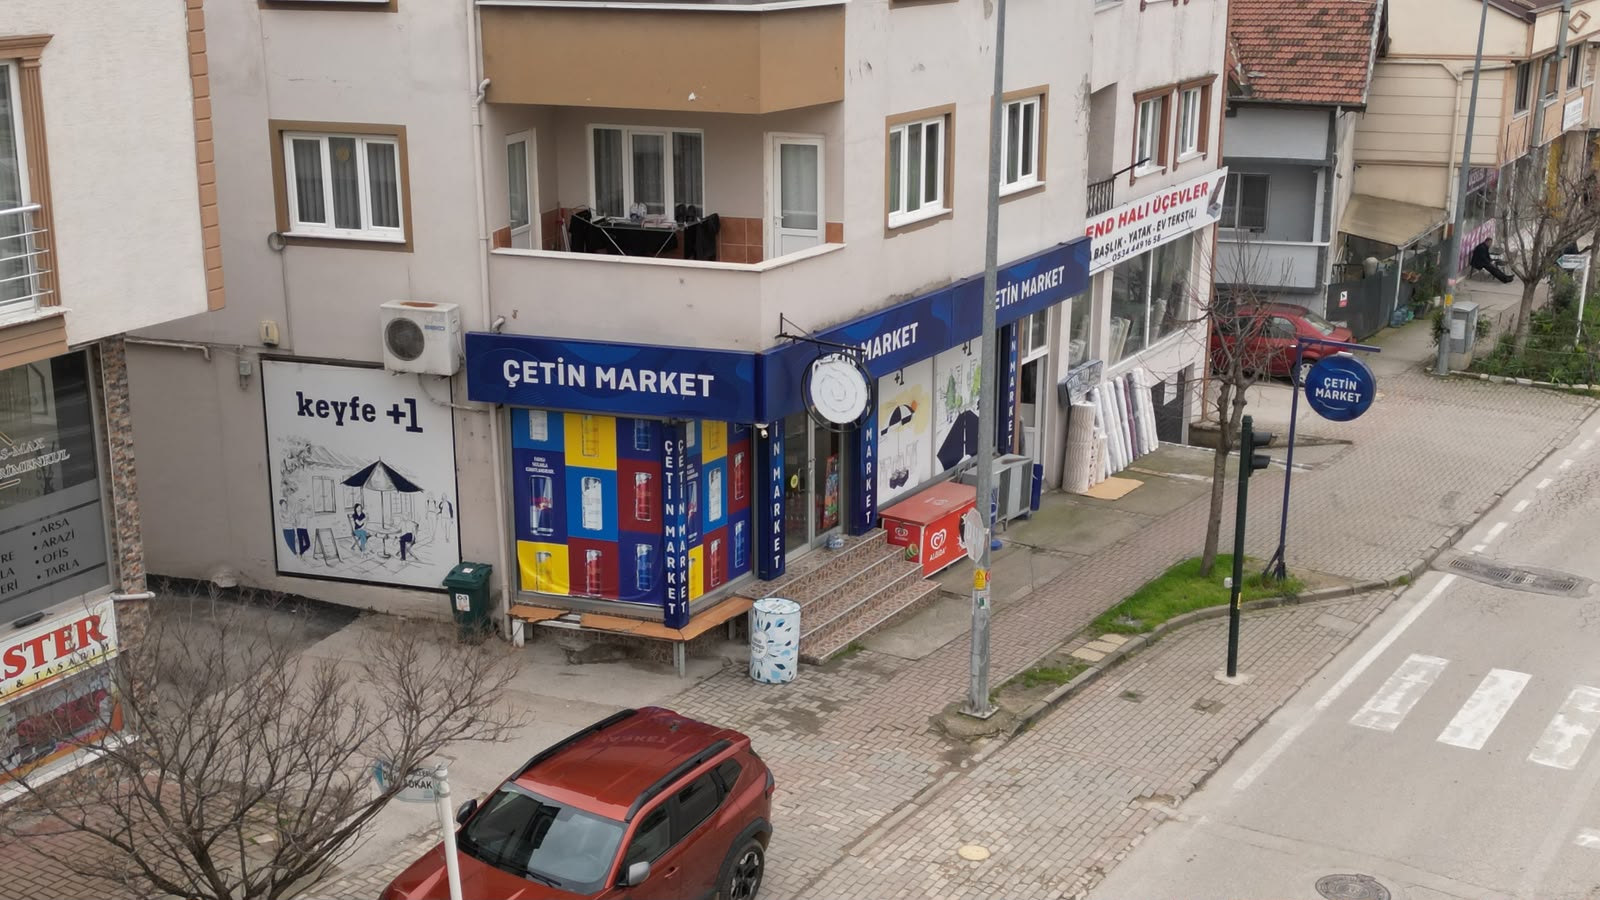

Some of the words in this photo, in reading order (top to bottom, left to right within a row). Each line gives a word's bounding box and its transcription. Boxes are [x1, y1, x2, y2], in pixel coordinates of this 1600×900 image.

[1086, 217, 1115, 239] END
[1118, 202, 1150, 229] HALI
[1153, 181, 1208, 214] ÜÇEVLER
[1094, 237, 1123, 261] BAŞLIK
[1129, 223, 1152, 243] YATAK
[1156, 218, 1166, 232] EV
[1167, 208, 1197, 227] TEKSTİLİ
[1112, 248, 1129, 262] 0534
[995, 281, 1018, 310] ETİN
[1021, 265, 1065, 300] MARKET
[861, 322, 919, 363] MARKET
[503, 357, 585, 387] ÇETİN
[595, 366, 714, 397] MARKET
[1324, 378, 1357, 391] ÇETİN
[1008, 360, 1016, 446] MARKET
[1316, 388, 1361, 402] MARKET
[296, 391, 376, 426] keyfe
[386, 398, 423, 433] +1
[0, 437, 45, 461] S-MAX
[0, 449, 71, 480] RİMENKUL
[664, 439, 675, 516] ÇETİN
[40, 518, 70, 535] ARSA
[773, 466, 781, 569] MARKET
[41, 528, 75, 550] ARAZİ
[1, 551, 15, 564] RE
[42, 547, 69, 564] OFİS
[0, 567, 15, 579] LA
[45, 559, 80, 577] TARLA
[665, 524, 676, 615] MARKET
[0, 578, 18, 594] ERİ
[0, 614, 108, 684] STER
[16, 679, 24, 688] &
[408, 780, 432, 789] OKAK
